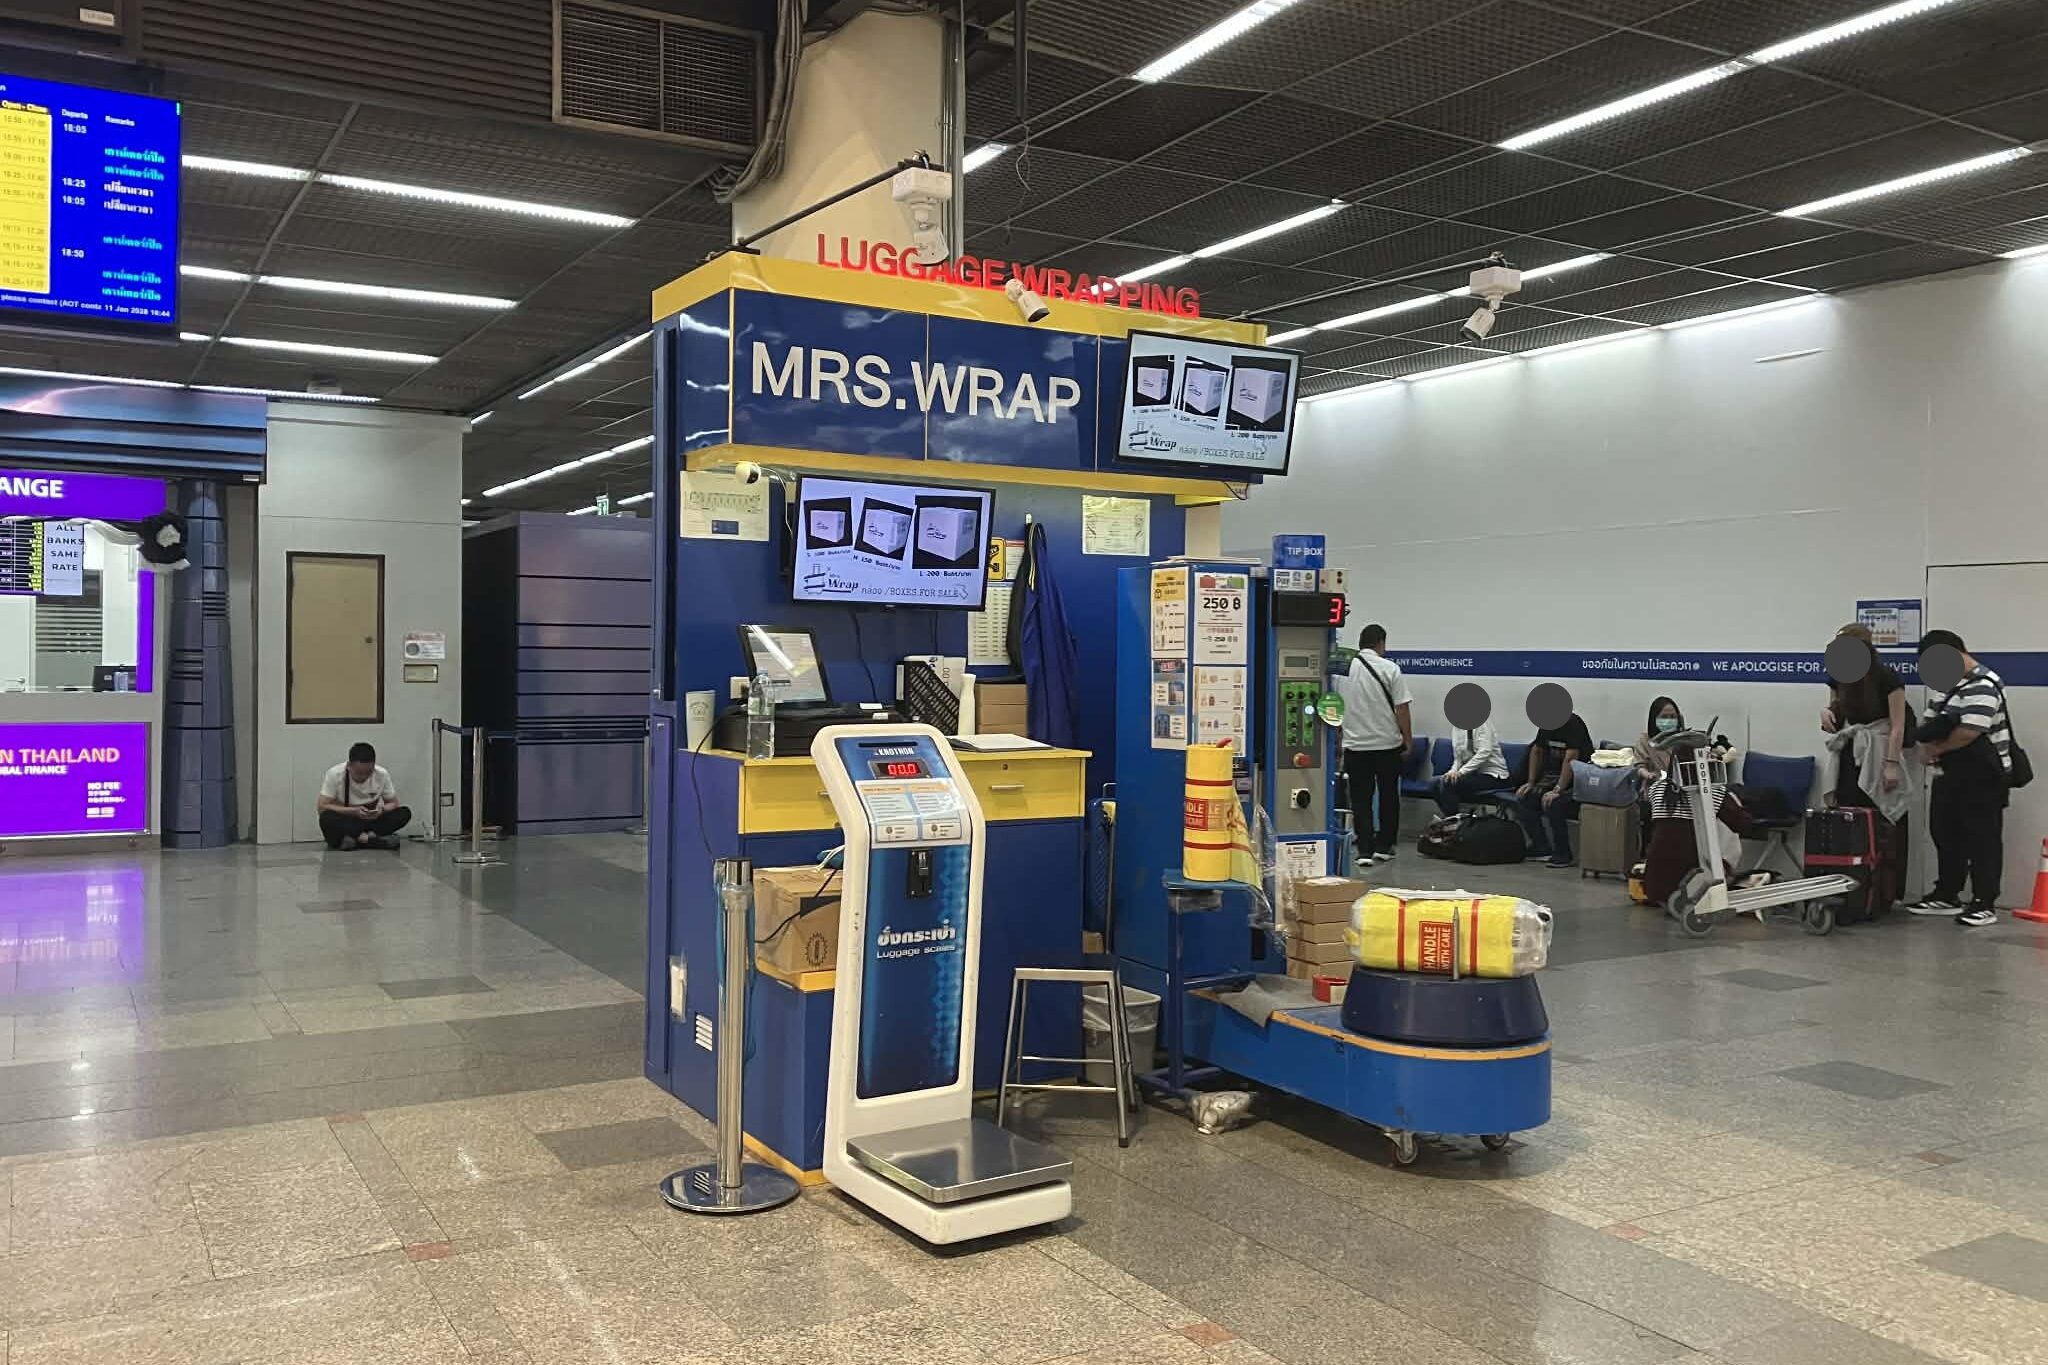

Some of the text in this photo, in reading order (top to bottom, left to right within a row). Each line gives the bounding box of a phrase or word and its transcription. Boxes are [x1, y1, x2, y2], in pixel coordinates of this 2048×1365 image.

[1011, 262, 1200, 318] WRAPPING
[1149, 436, 1177, 449] Wrap
[0, 477, 64, 498] ANGE
[56, 524, 76, 532] ALL
[47, 537, 84, 545] BANKS
[50, 550, 79, 558] SAME
[1288, 547, 1323, 556] TIP BOX
[52, 563, 78, 571] RATE
[828, 578, 859, 591] Wrap
[919, 587, 936, 597] FOR
[1203, 597, 1229, 609] 250
[1329, 598, 1342, 624] 3
[1411, 658, 1474, 667] INCONVENIENCE
[1712, 661, 1820, 673] WE APOLOGISE FOR
[19, 747, 120, 763] THAILAND
[24, 765, 68, 775] FINANCE
[876, 946, 920, 959] Luggage
[1424, 926, 1437, 969] HANDLE
[1440, 949, 1450, 970] WITH
